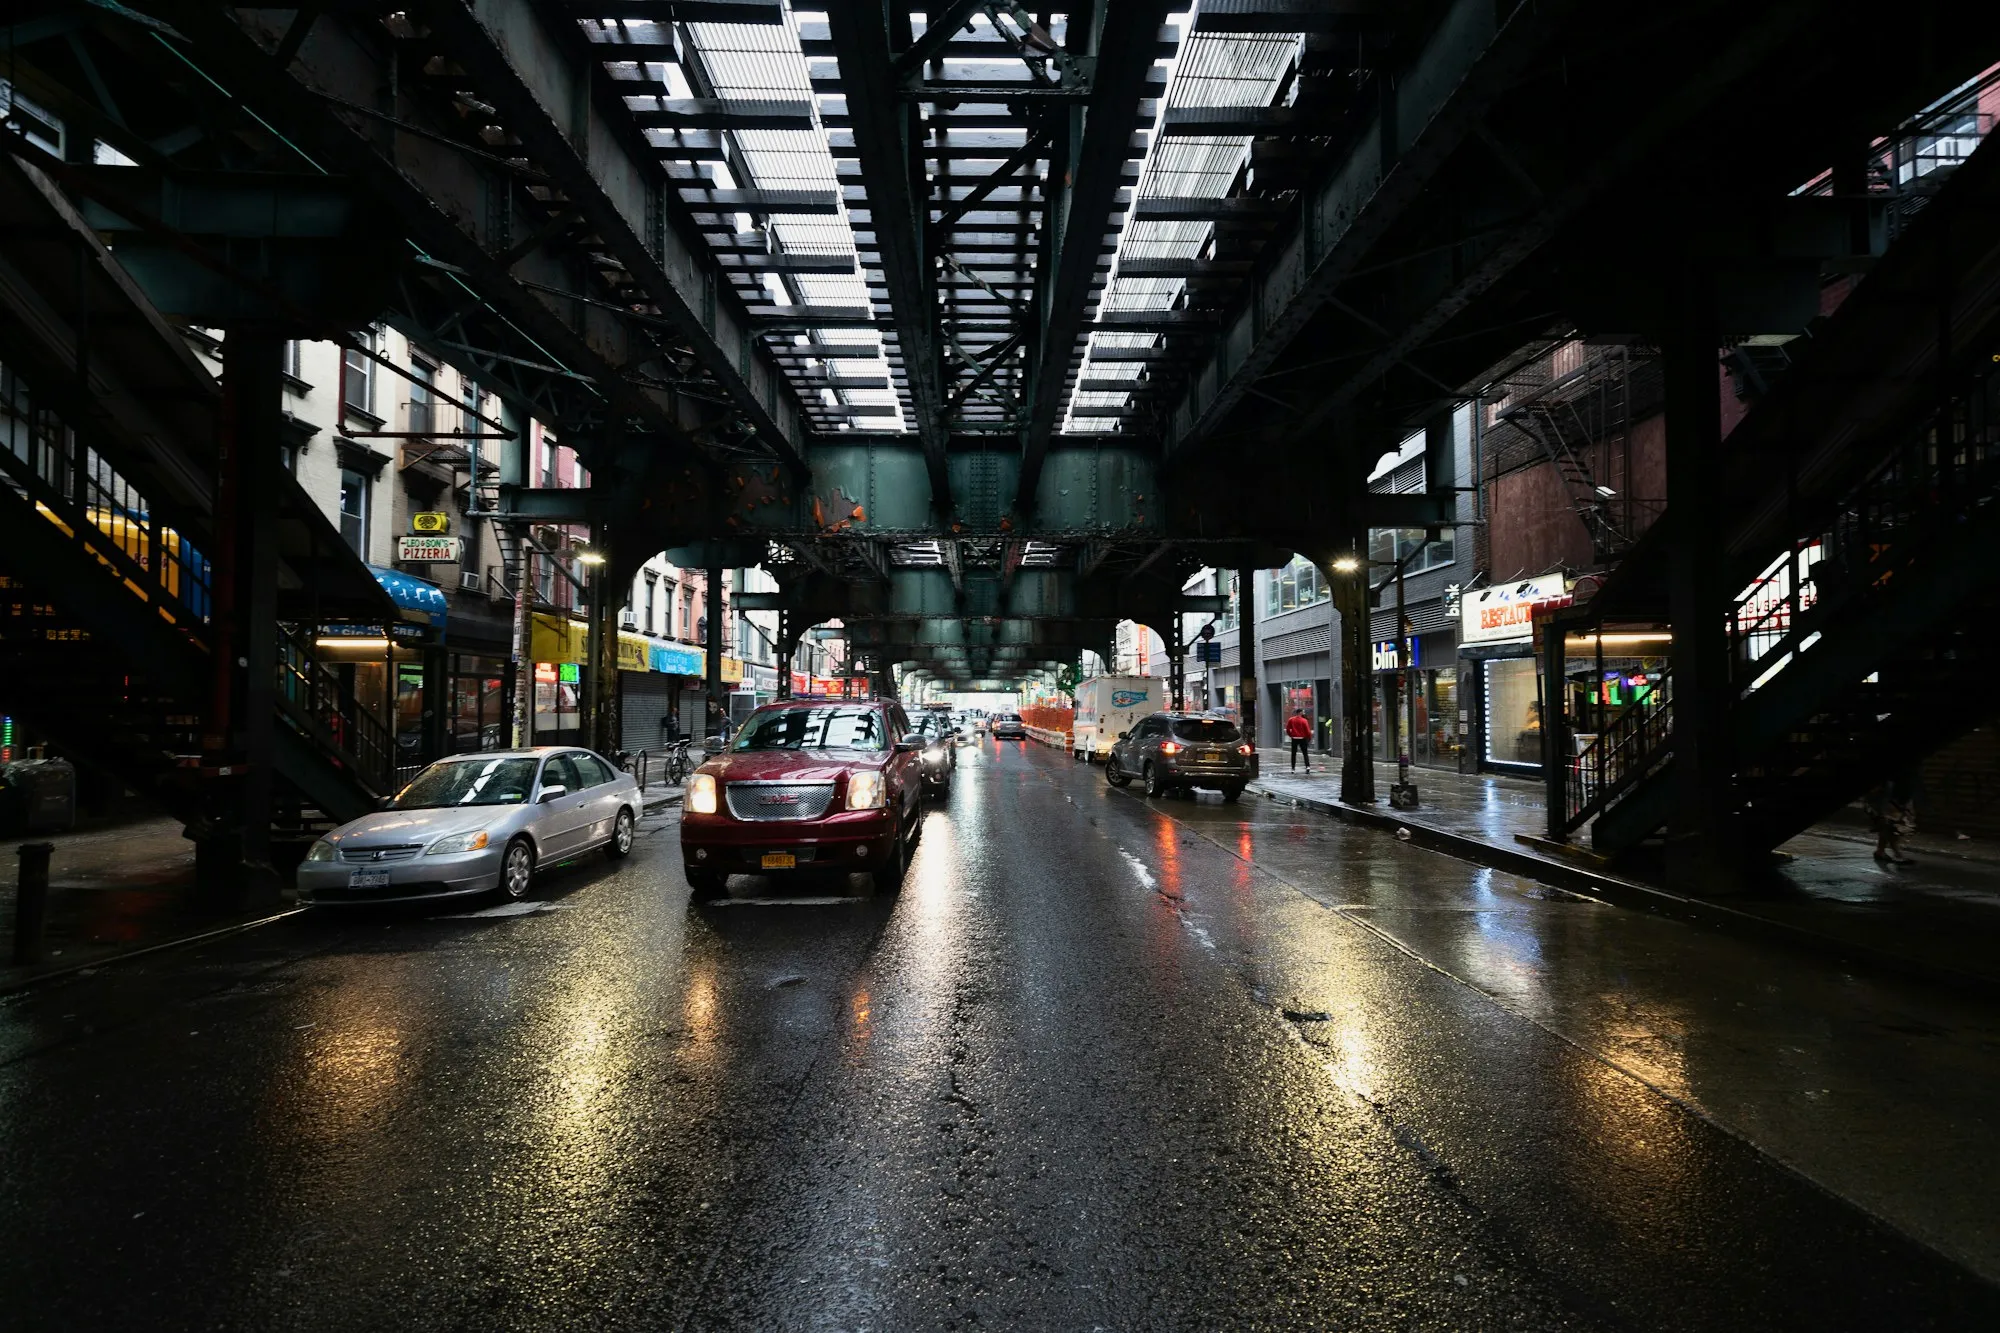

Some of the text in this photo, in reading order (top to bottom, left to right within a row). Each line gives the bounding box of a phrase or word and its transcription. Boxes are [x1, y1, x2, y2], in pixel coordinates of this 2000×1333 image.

[407, 539, 420, 547] LEO
[403, 548, 450, 559] PIZZERIA
[1444, 584, 1460, 617] blink
[1372, 641, 1399, 670] blin
